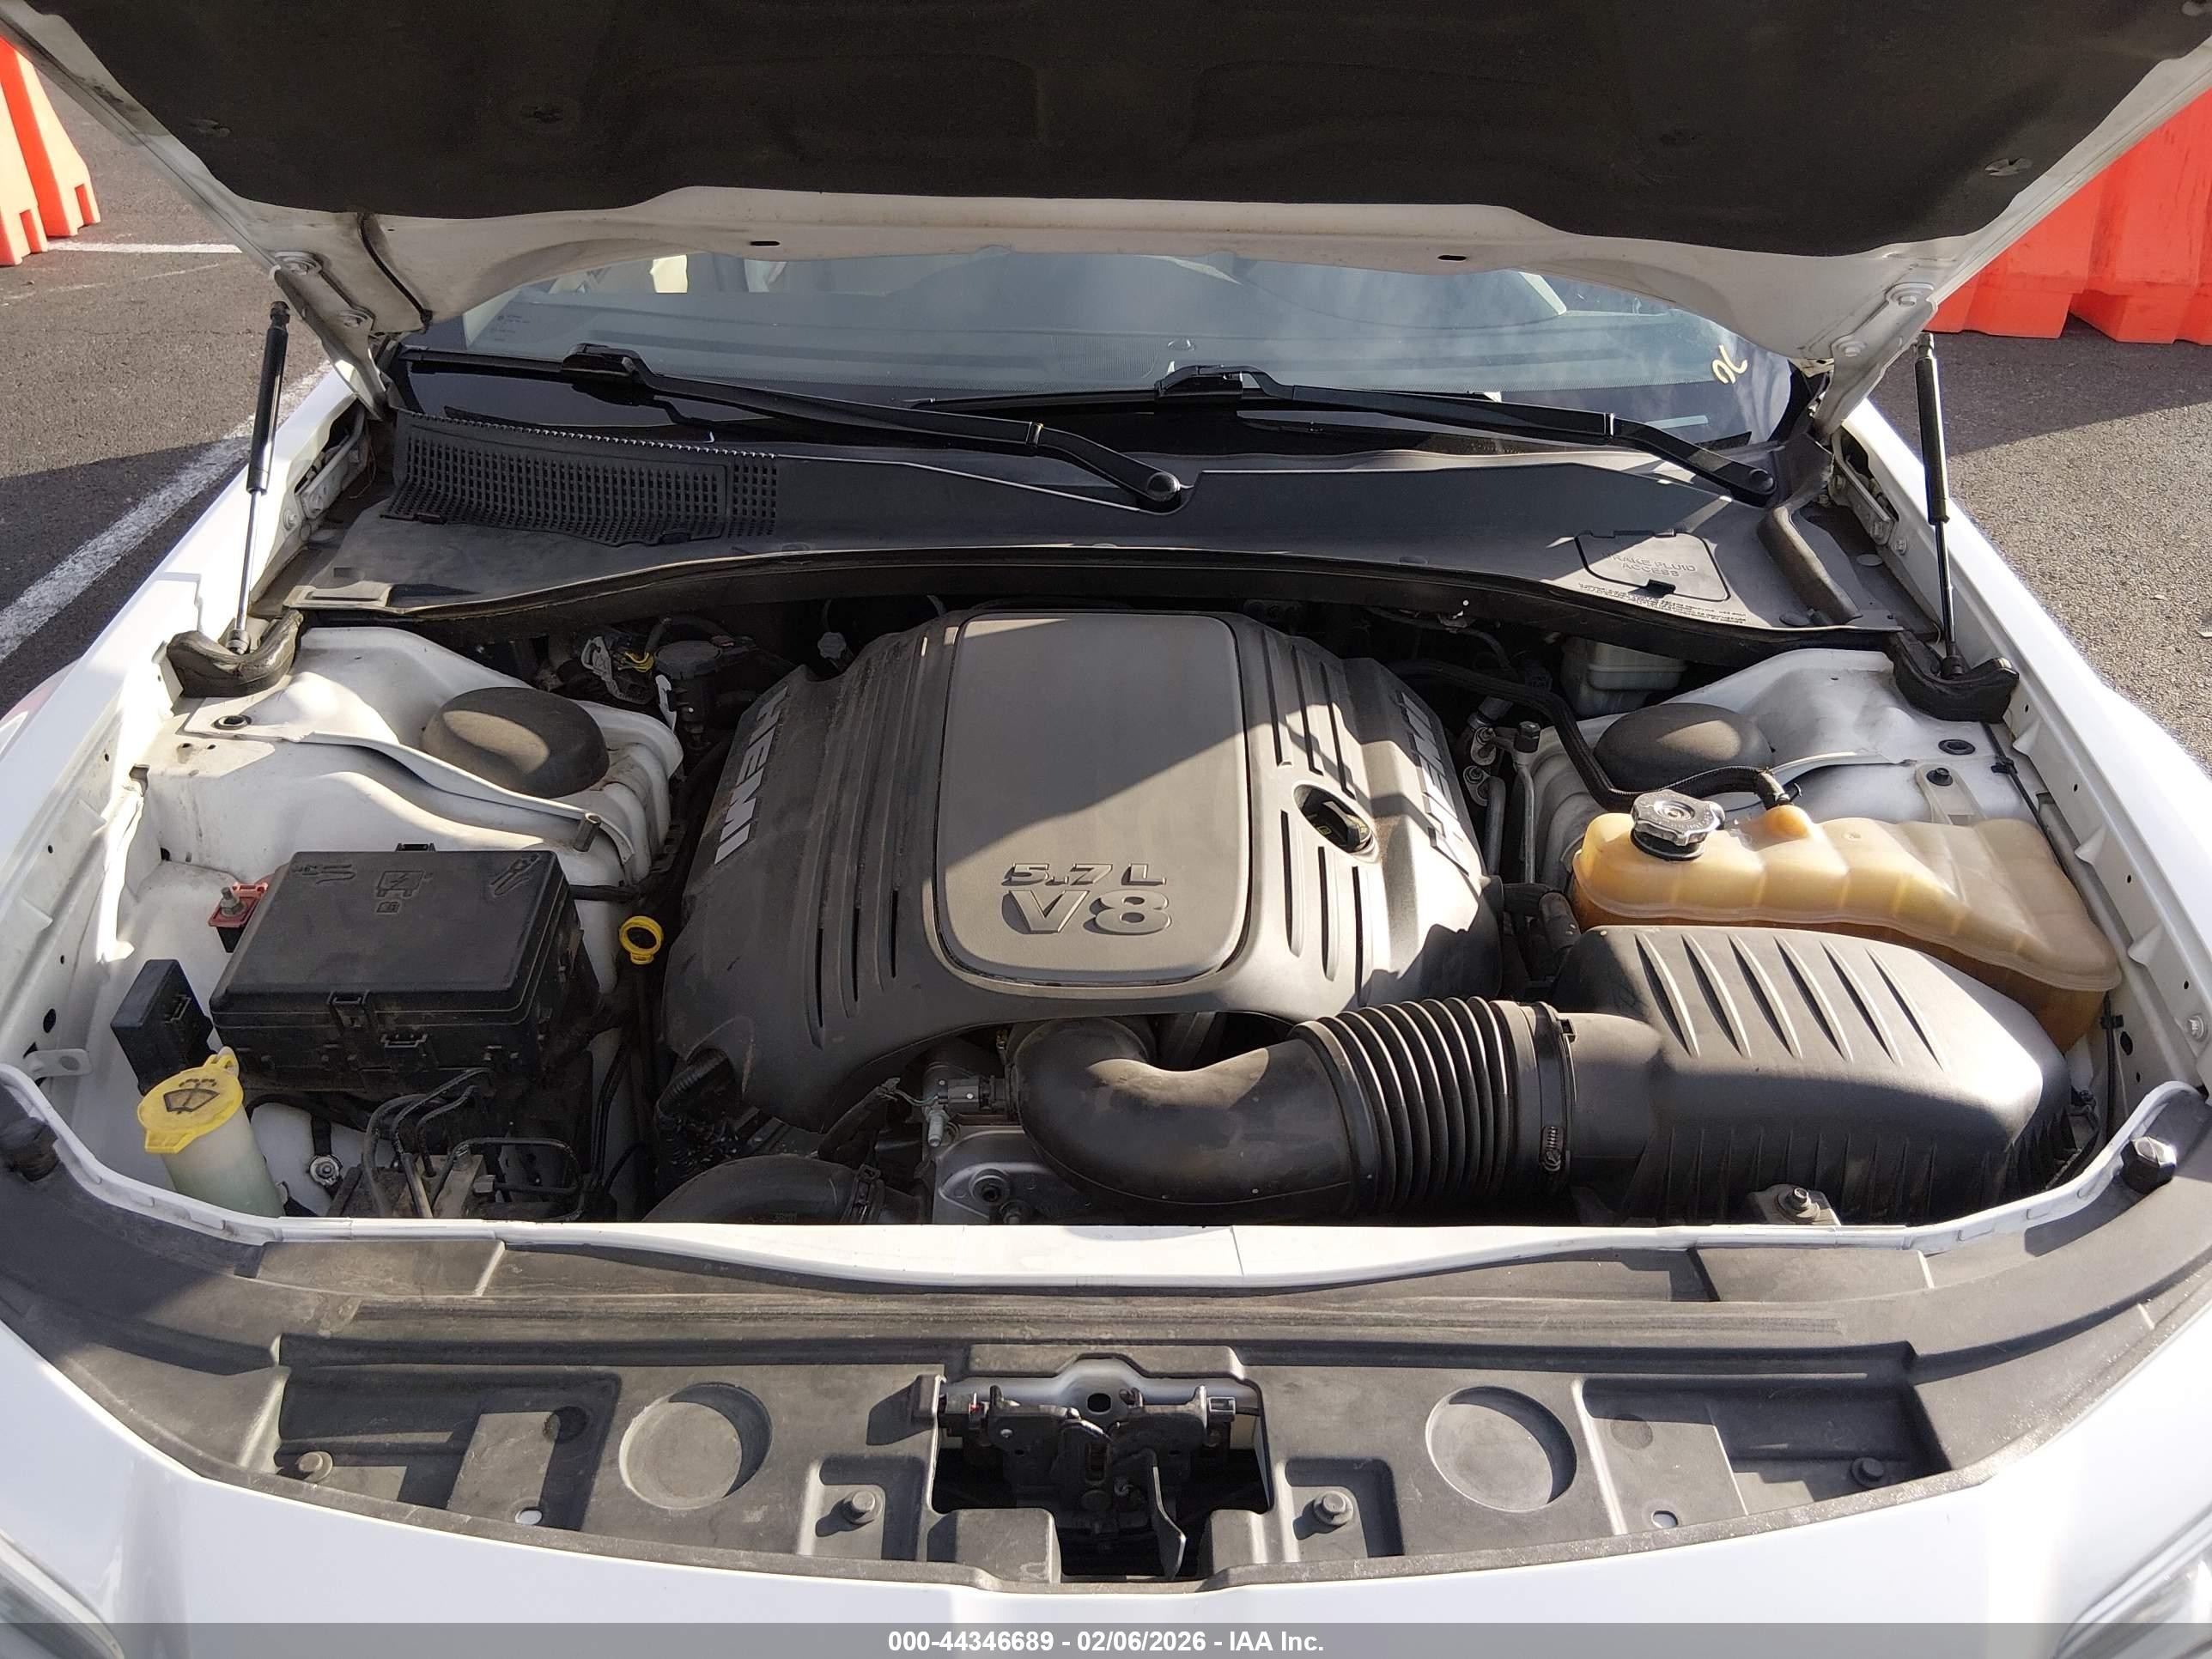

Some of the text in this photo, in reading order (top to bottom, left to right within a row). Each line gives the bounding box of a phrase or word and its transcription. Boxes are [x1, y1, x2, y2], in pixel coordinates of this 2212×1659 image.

[1621, 562, 1680, 578] ACCESS
[1654, 561, 1697, 573] FLUID
[714, 684, 788, 865] HEMI
[1006, 890, 1173, 935] V8
